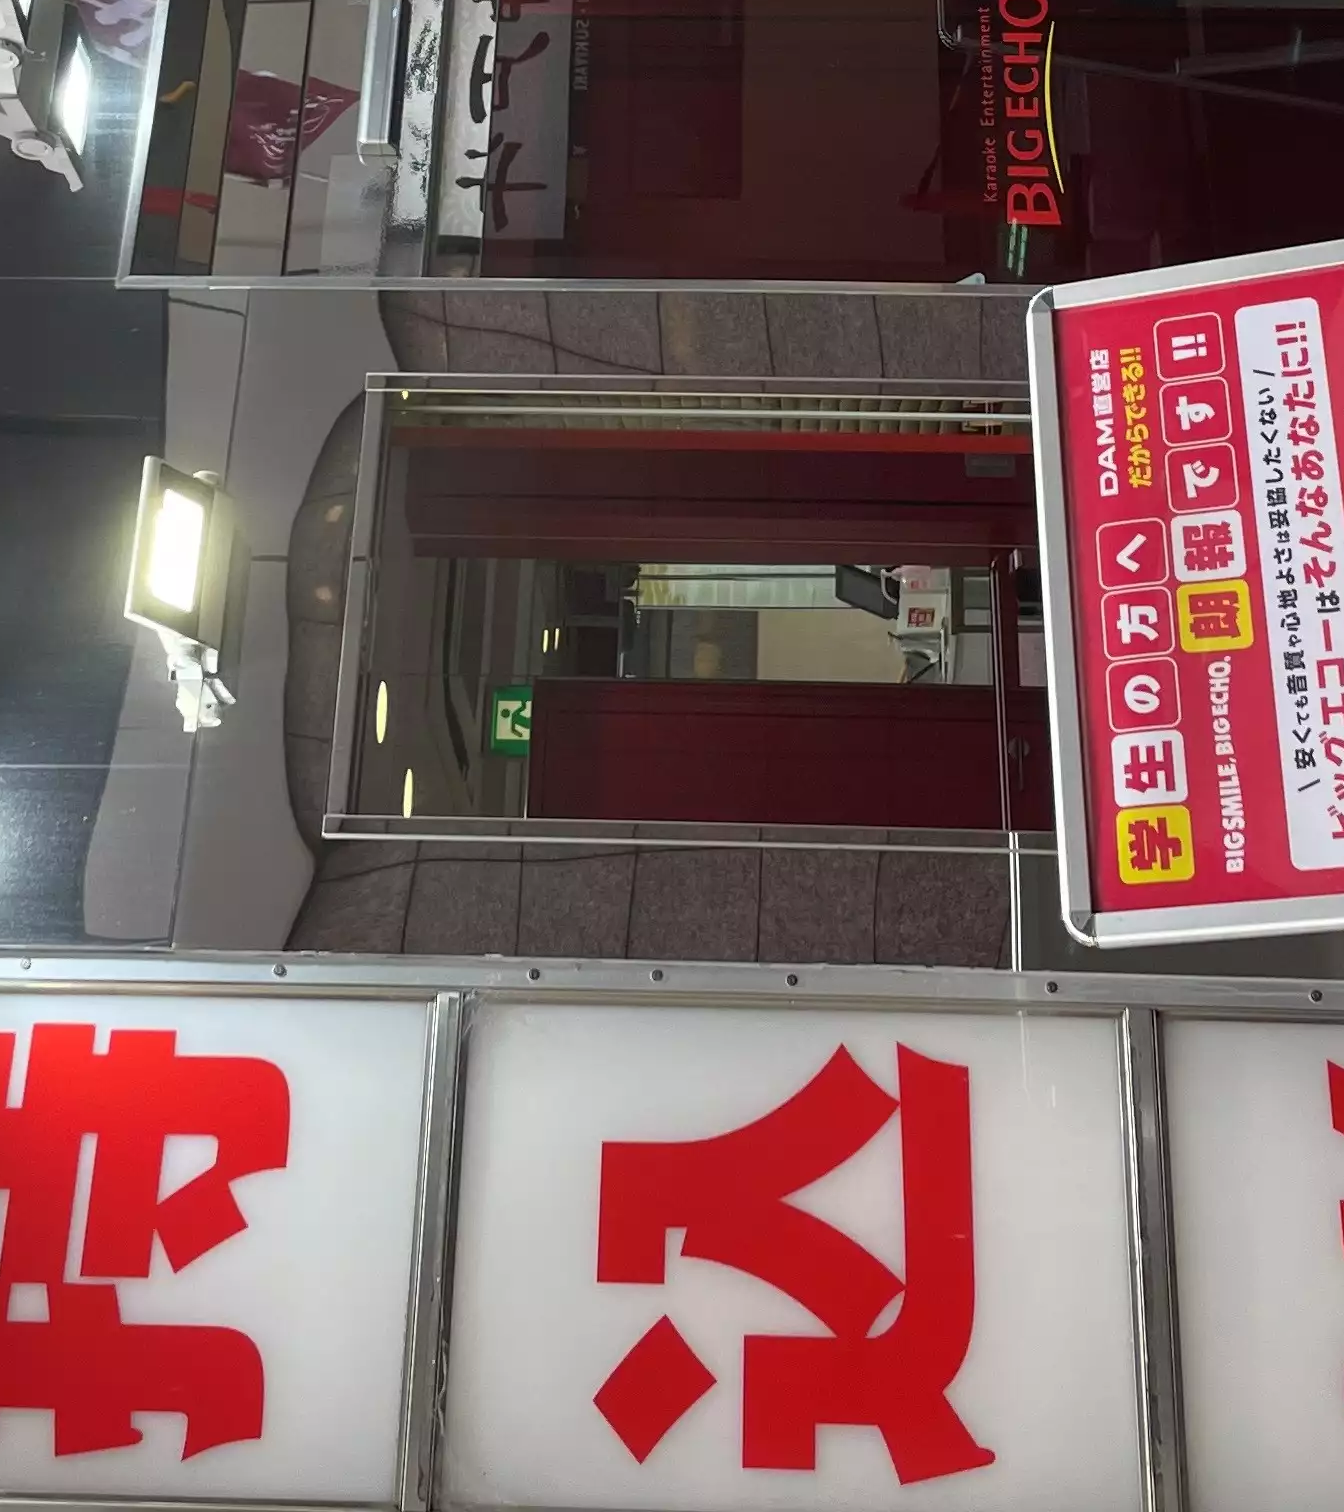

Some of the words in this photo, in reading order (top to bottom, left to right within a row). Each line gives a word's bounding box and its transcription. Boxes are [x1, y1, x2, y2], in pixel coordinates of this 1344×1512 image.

[977, 5, 995, 126] Entertainment
[980, 137, 999, 202] Karaoke
[1005, 129, 1062, 225] BIG
[1119, 346, 1154, 489] だからできる!!
[1114, 531, 1185, 871] 学生の方へ
